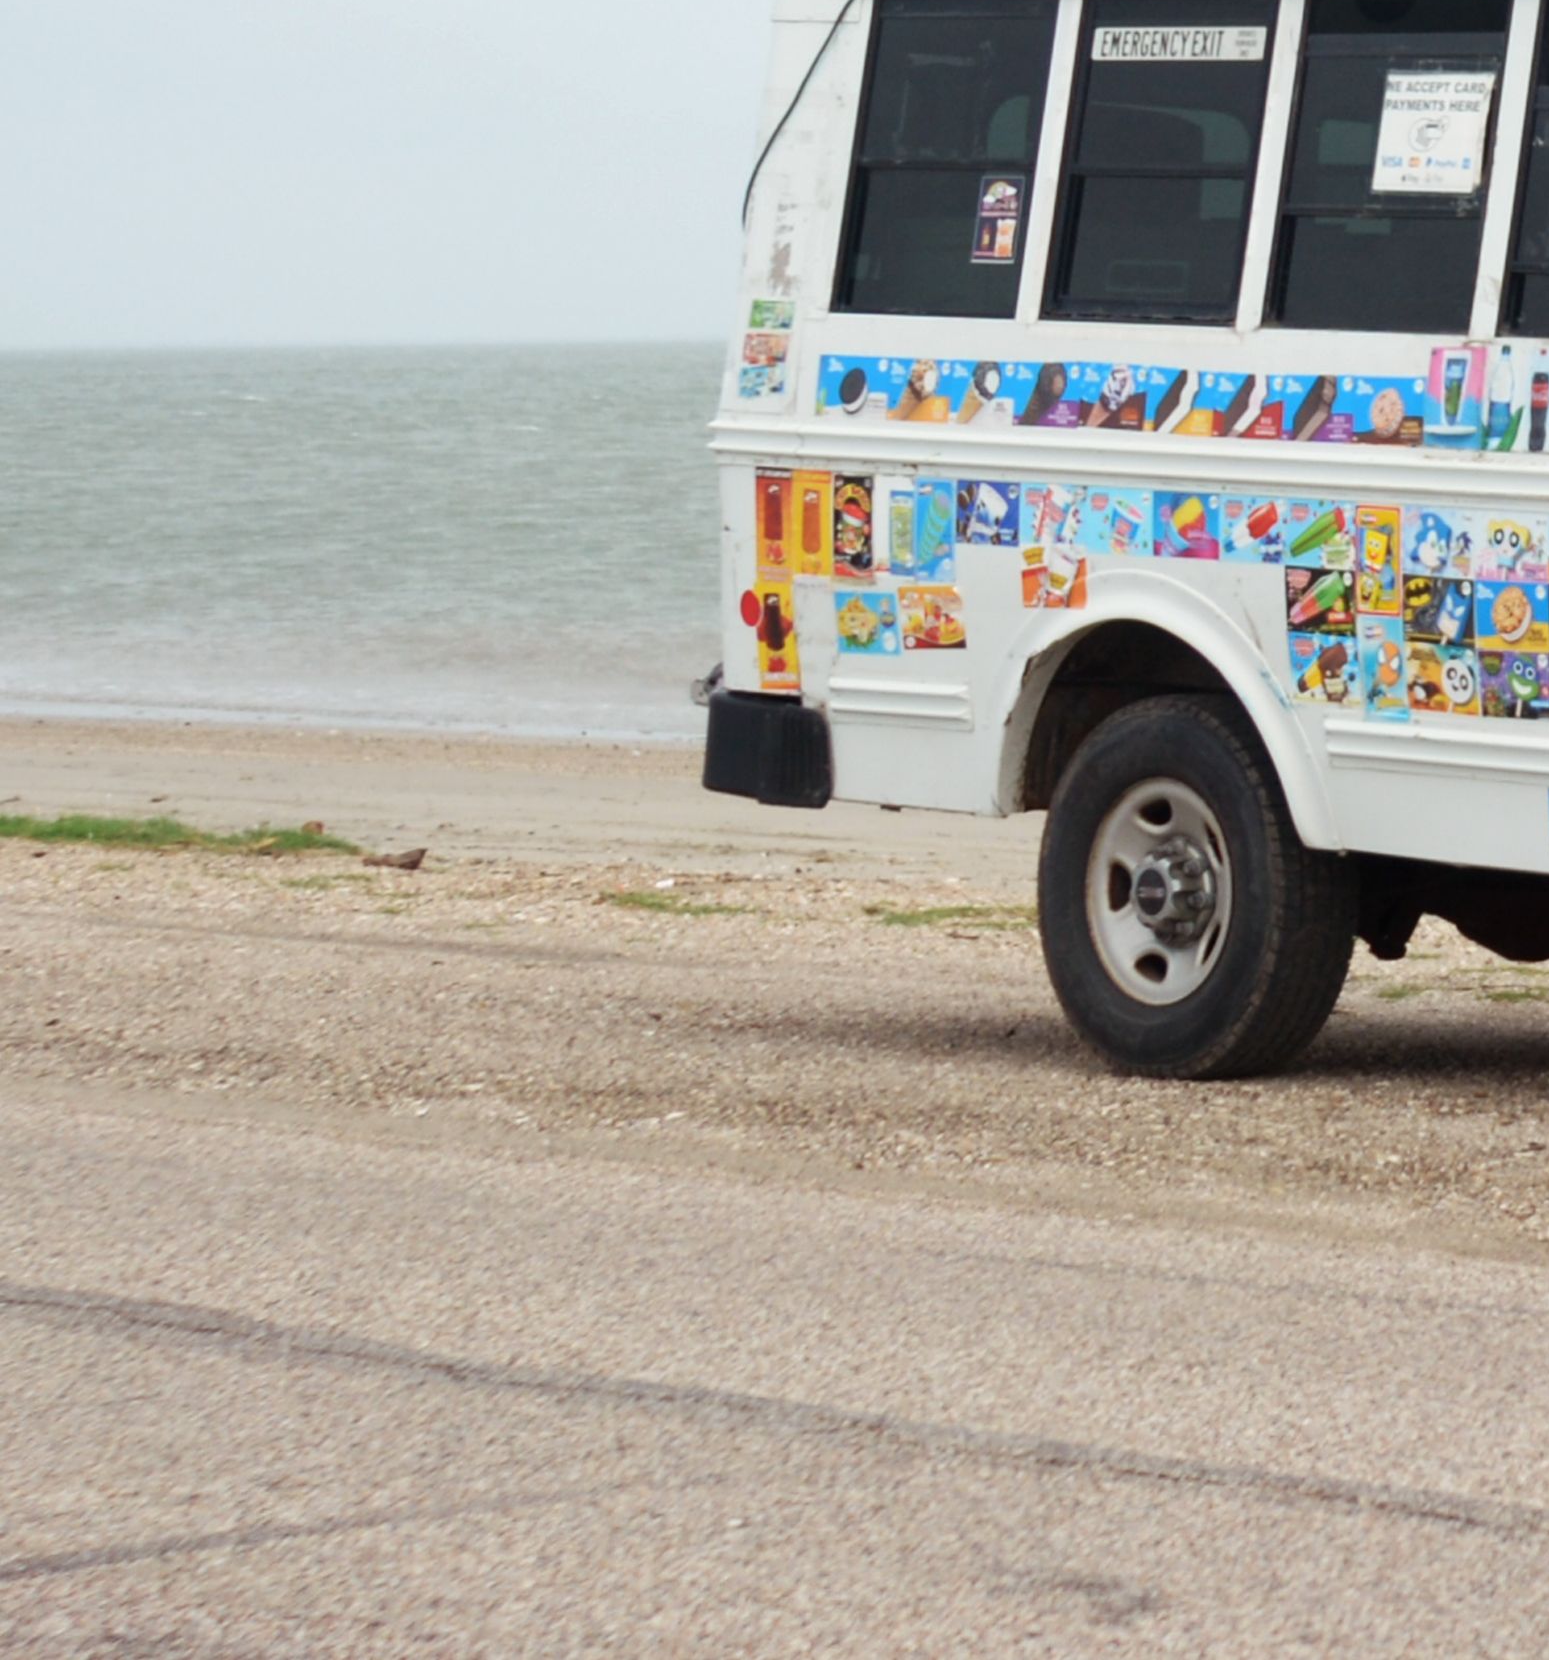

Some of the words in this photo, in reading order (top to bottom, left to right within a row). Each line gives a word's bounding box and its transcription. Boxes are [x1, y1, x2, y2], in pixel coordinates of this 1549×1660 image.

[1100, 30, 1191, 58] EMERGENCY
[1191, 30, 1225, 57] EXIT
[1406, 81, 1451, 93] ACCEPT
[1454, 81, 1487, 94] CARD
[1385, 99, 1446, 112] PAYMENTS
[1449, 100, 1481, 112] HERE
